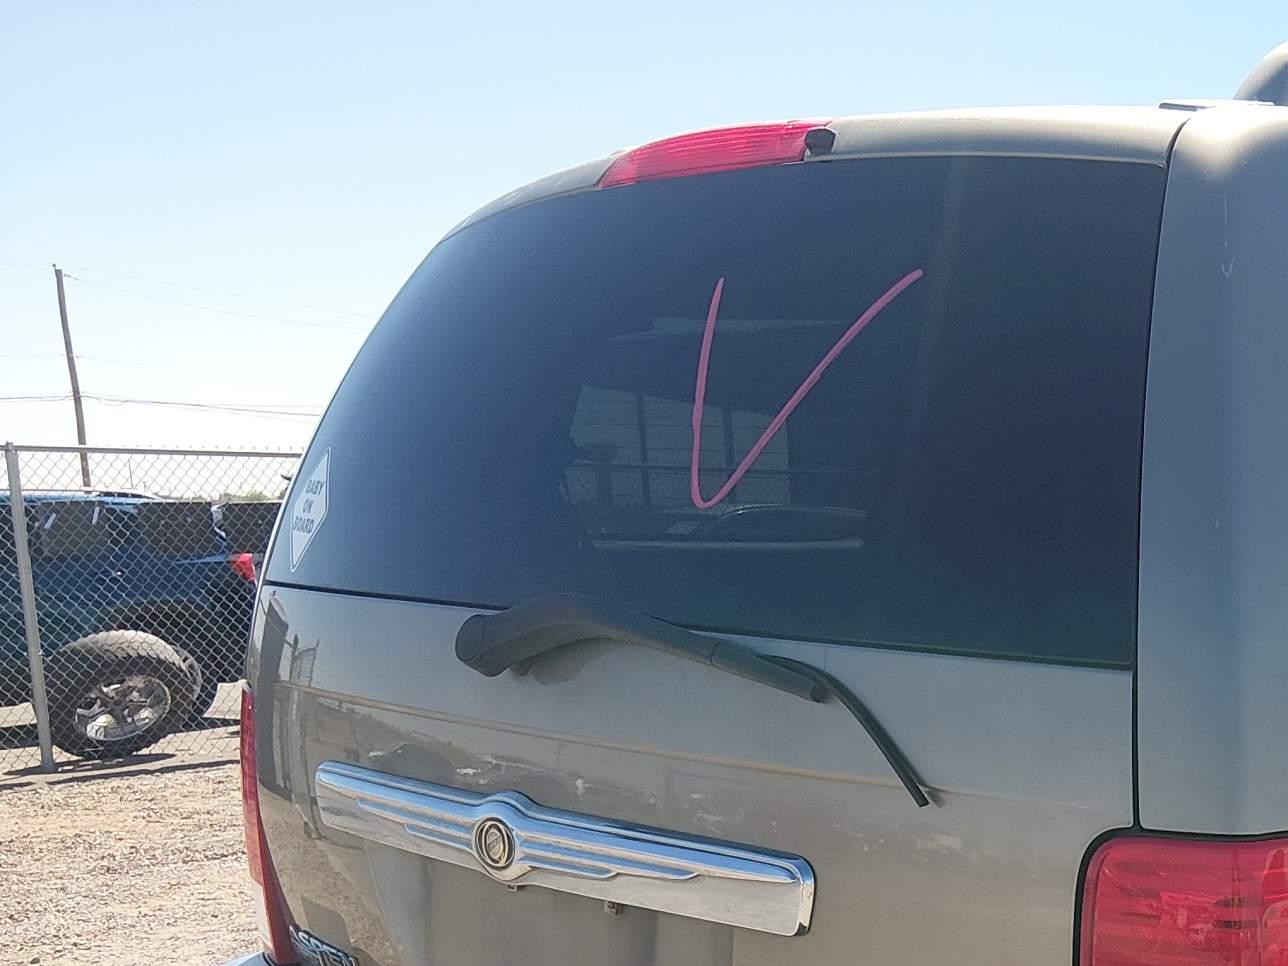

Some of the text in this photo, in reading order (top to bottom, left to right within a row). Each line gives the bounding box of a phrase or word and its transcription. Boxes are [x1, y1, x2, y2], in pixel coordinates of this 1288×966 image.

[305, 479, 325, 496] BABY
[302, 499, 314, 514] ON
[292, 515, 315, 534] BOARD
